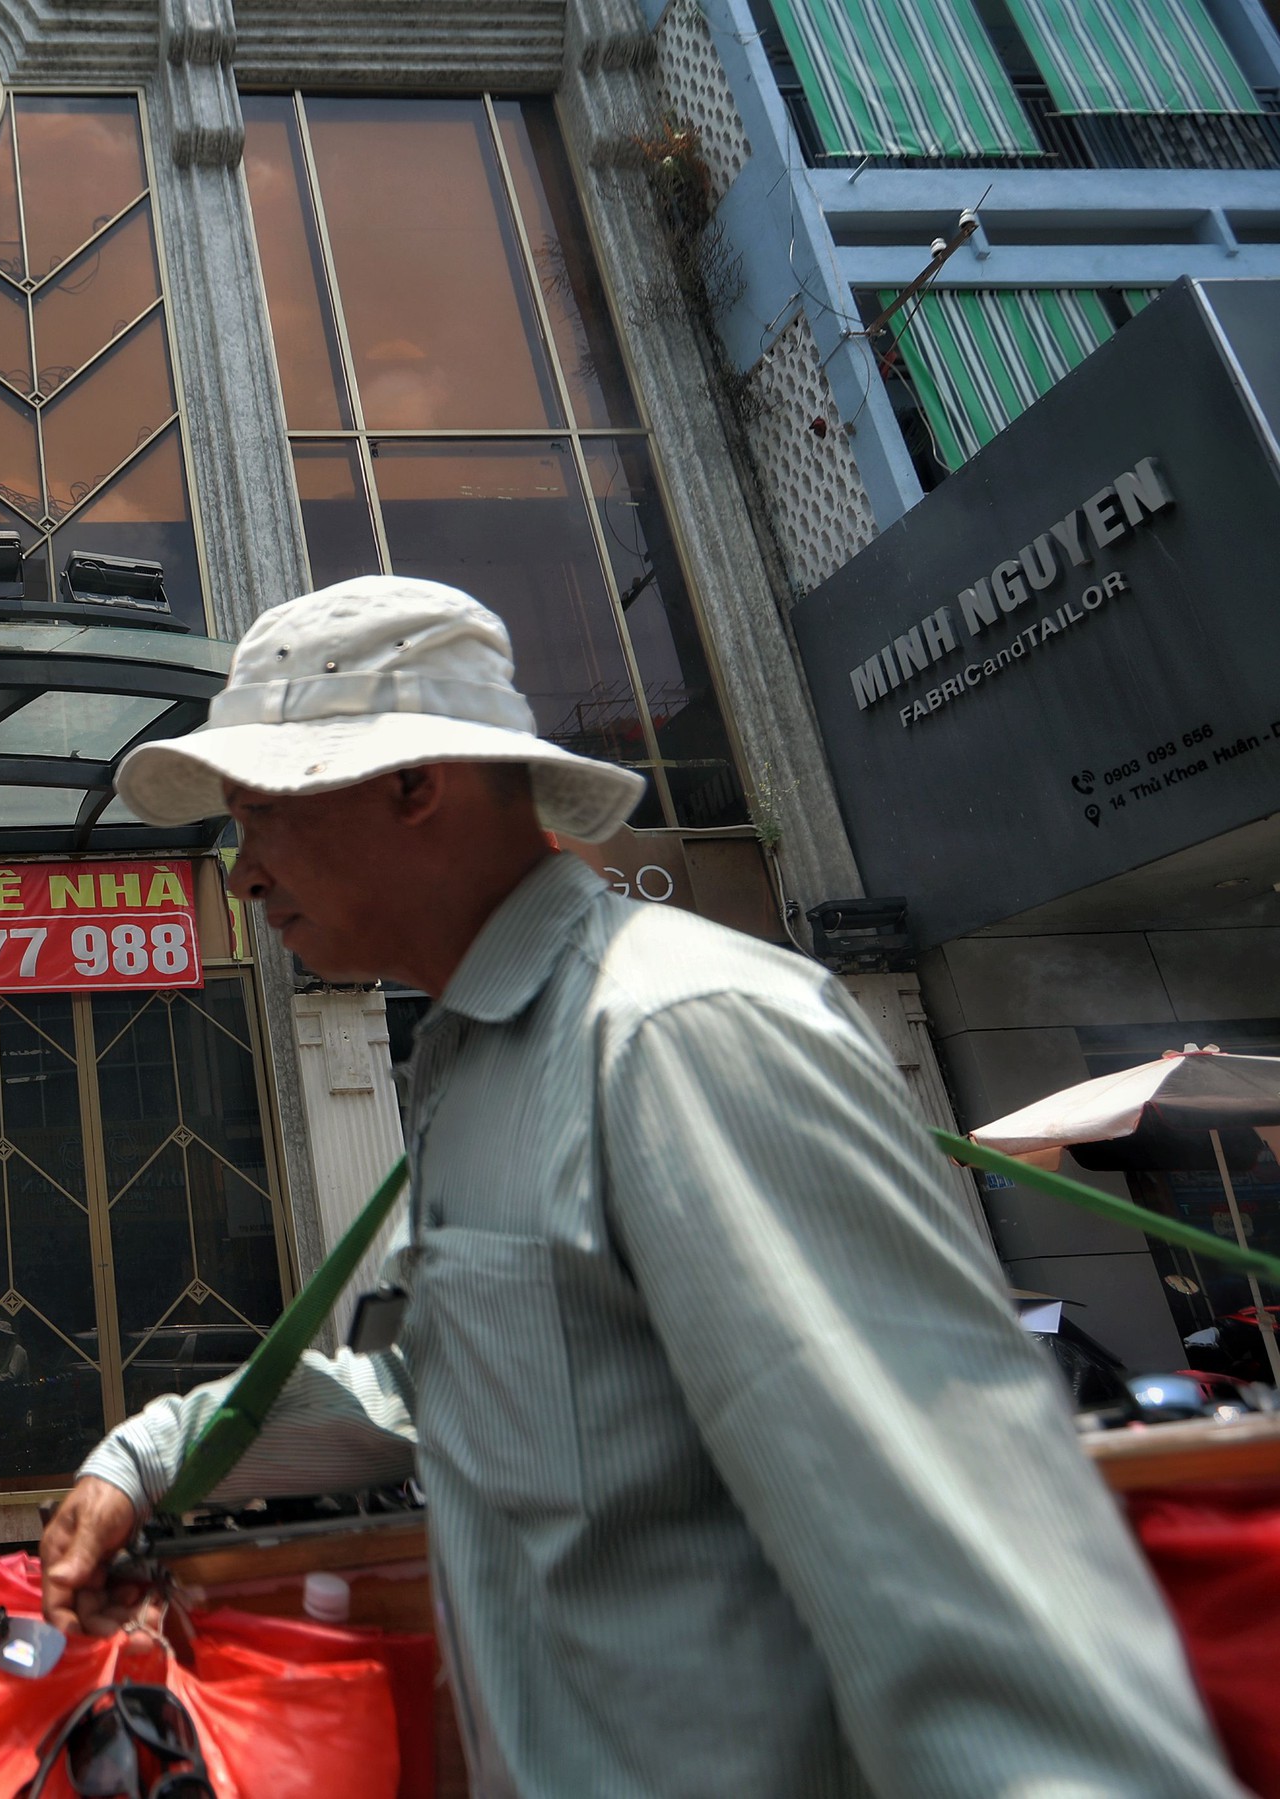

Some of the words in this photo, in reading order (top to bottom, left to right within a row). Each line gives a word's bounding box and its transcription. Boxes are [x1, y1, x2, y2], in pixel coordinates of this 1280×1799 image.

[849, 605, 959, 711] MINH
[957, 456, 1169, 637] NGUYEN
[1103, 759, 1141, 786] 0903
[1146, 741, 1178, 765] 093
[1181, 723, 1214, 748] 656
[1129, 776, 1162, 801] Thủ
[1163, 758, 1209, 787] Khoa
[48, 865, 190, 909] NHÀ
[71, 923, 189, 976] 988
